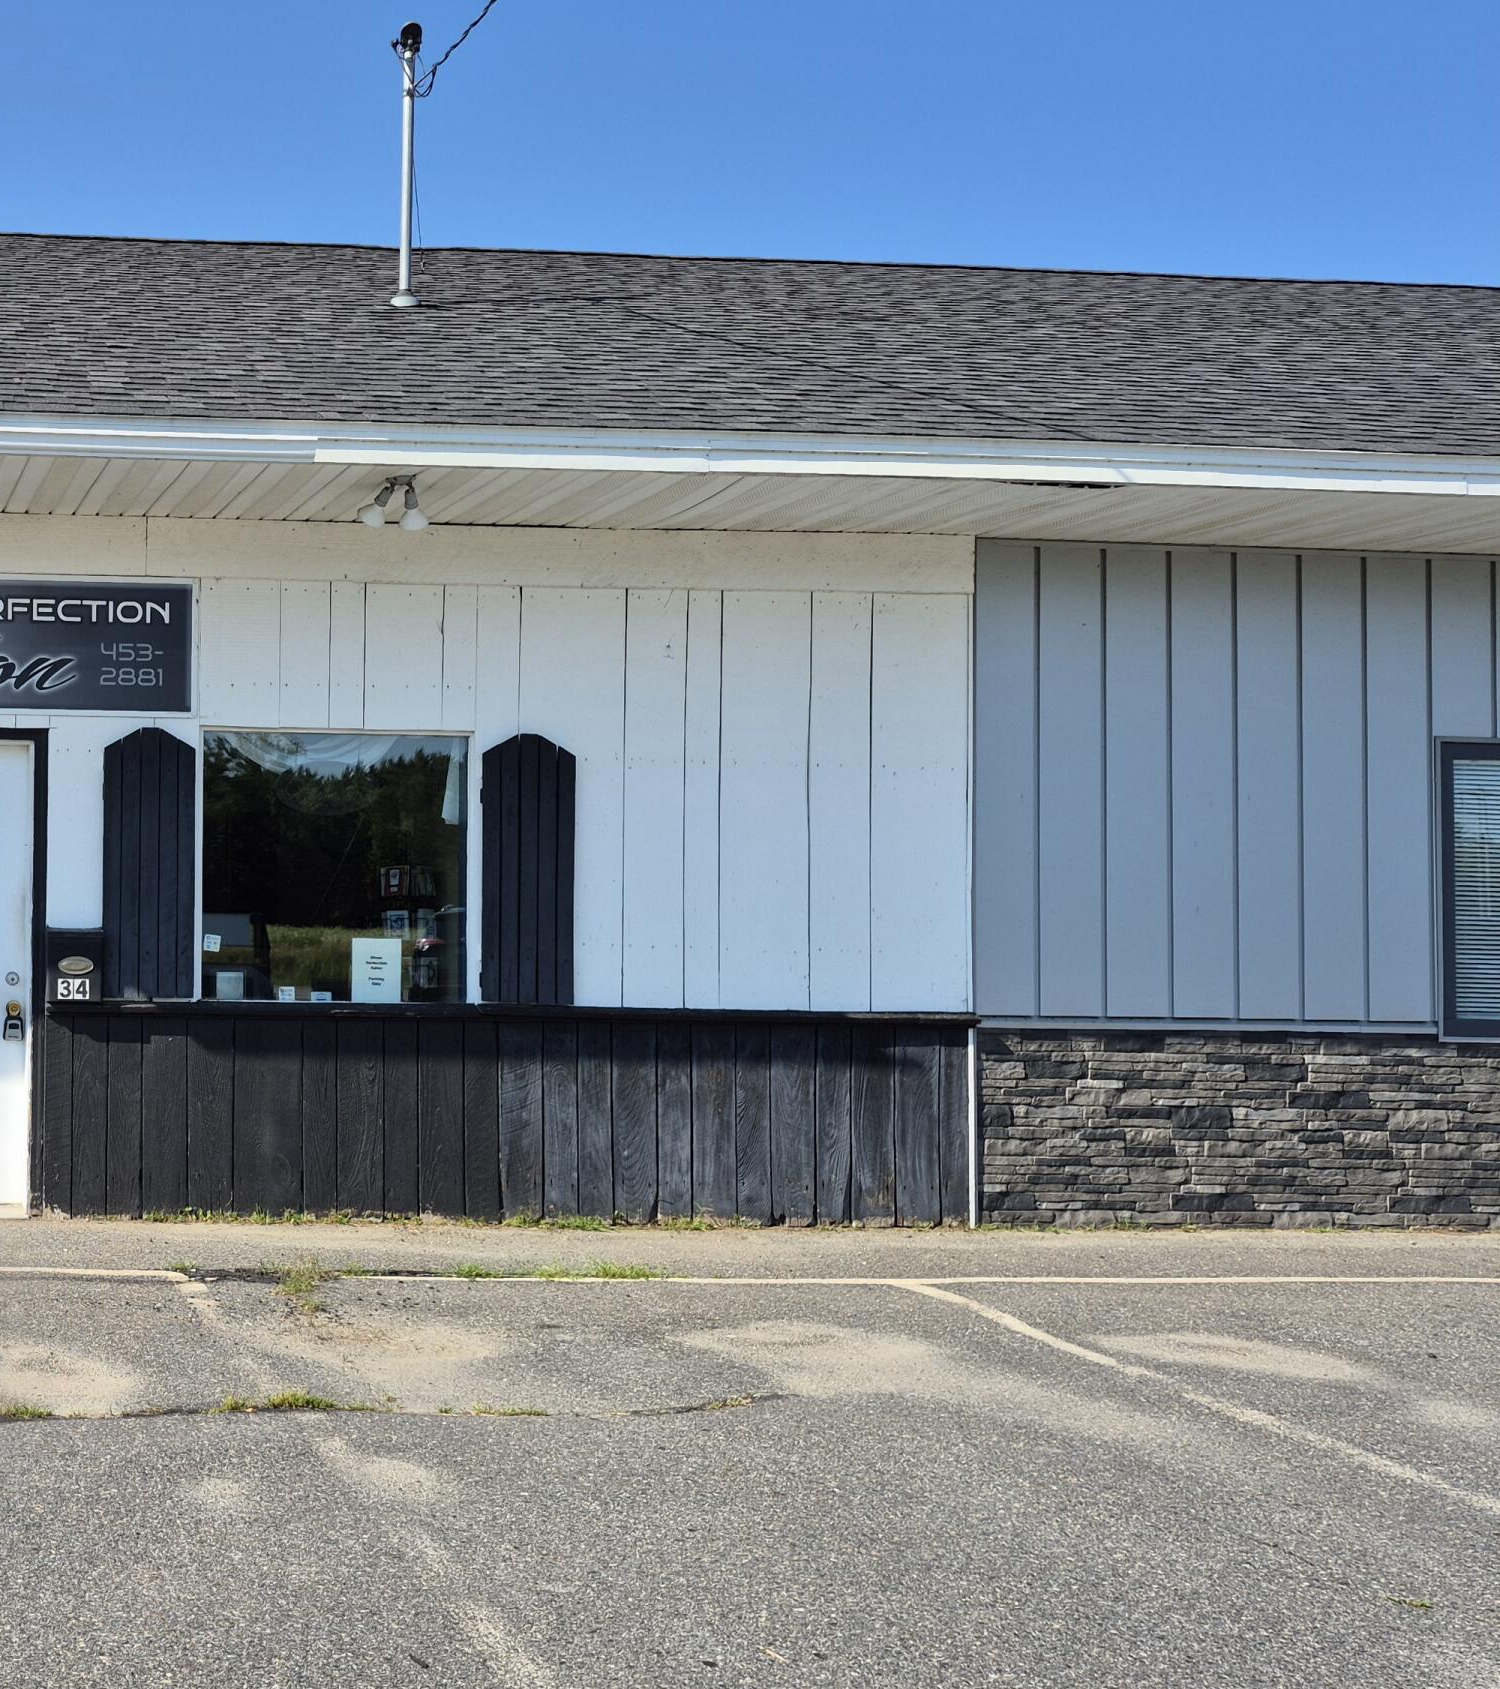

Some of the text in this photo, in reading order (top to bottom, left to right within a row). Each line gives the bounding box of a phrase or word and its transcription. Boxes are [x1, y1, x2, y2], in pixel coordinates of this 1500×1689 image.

[100, 641, 164, 662] 453-
[99, 666, 164, 688] 2881
[58, 979, 89, 999] 34
